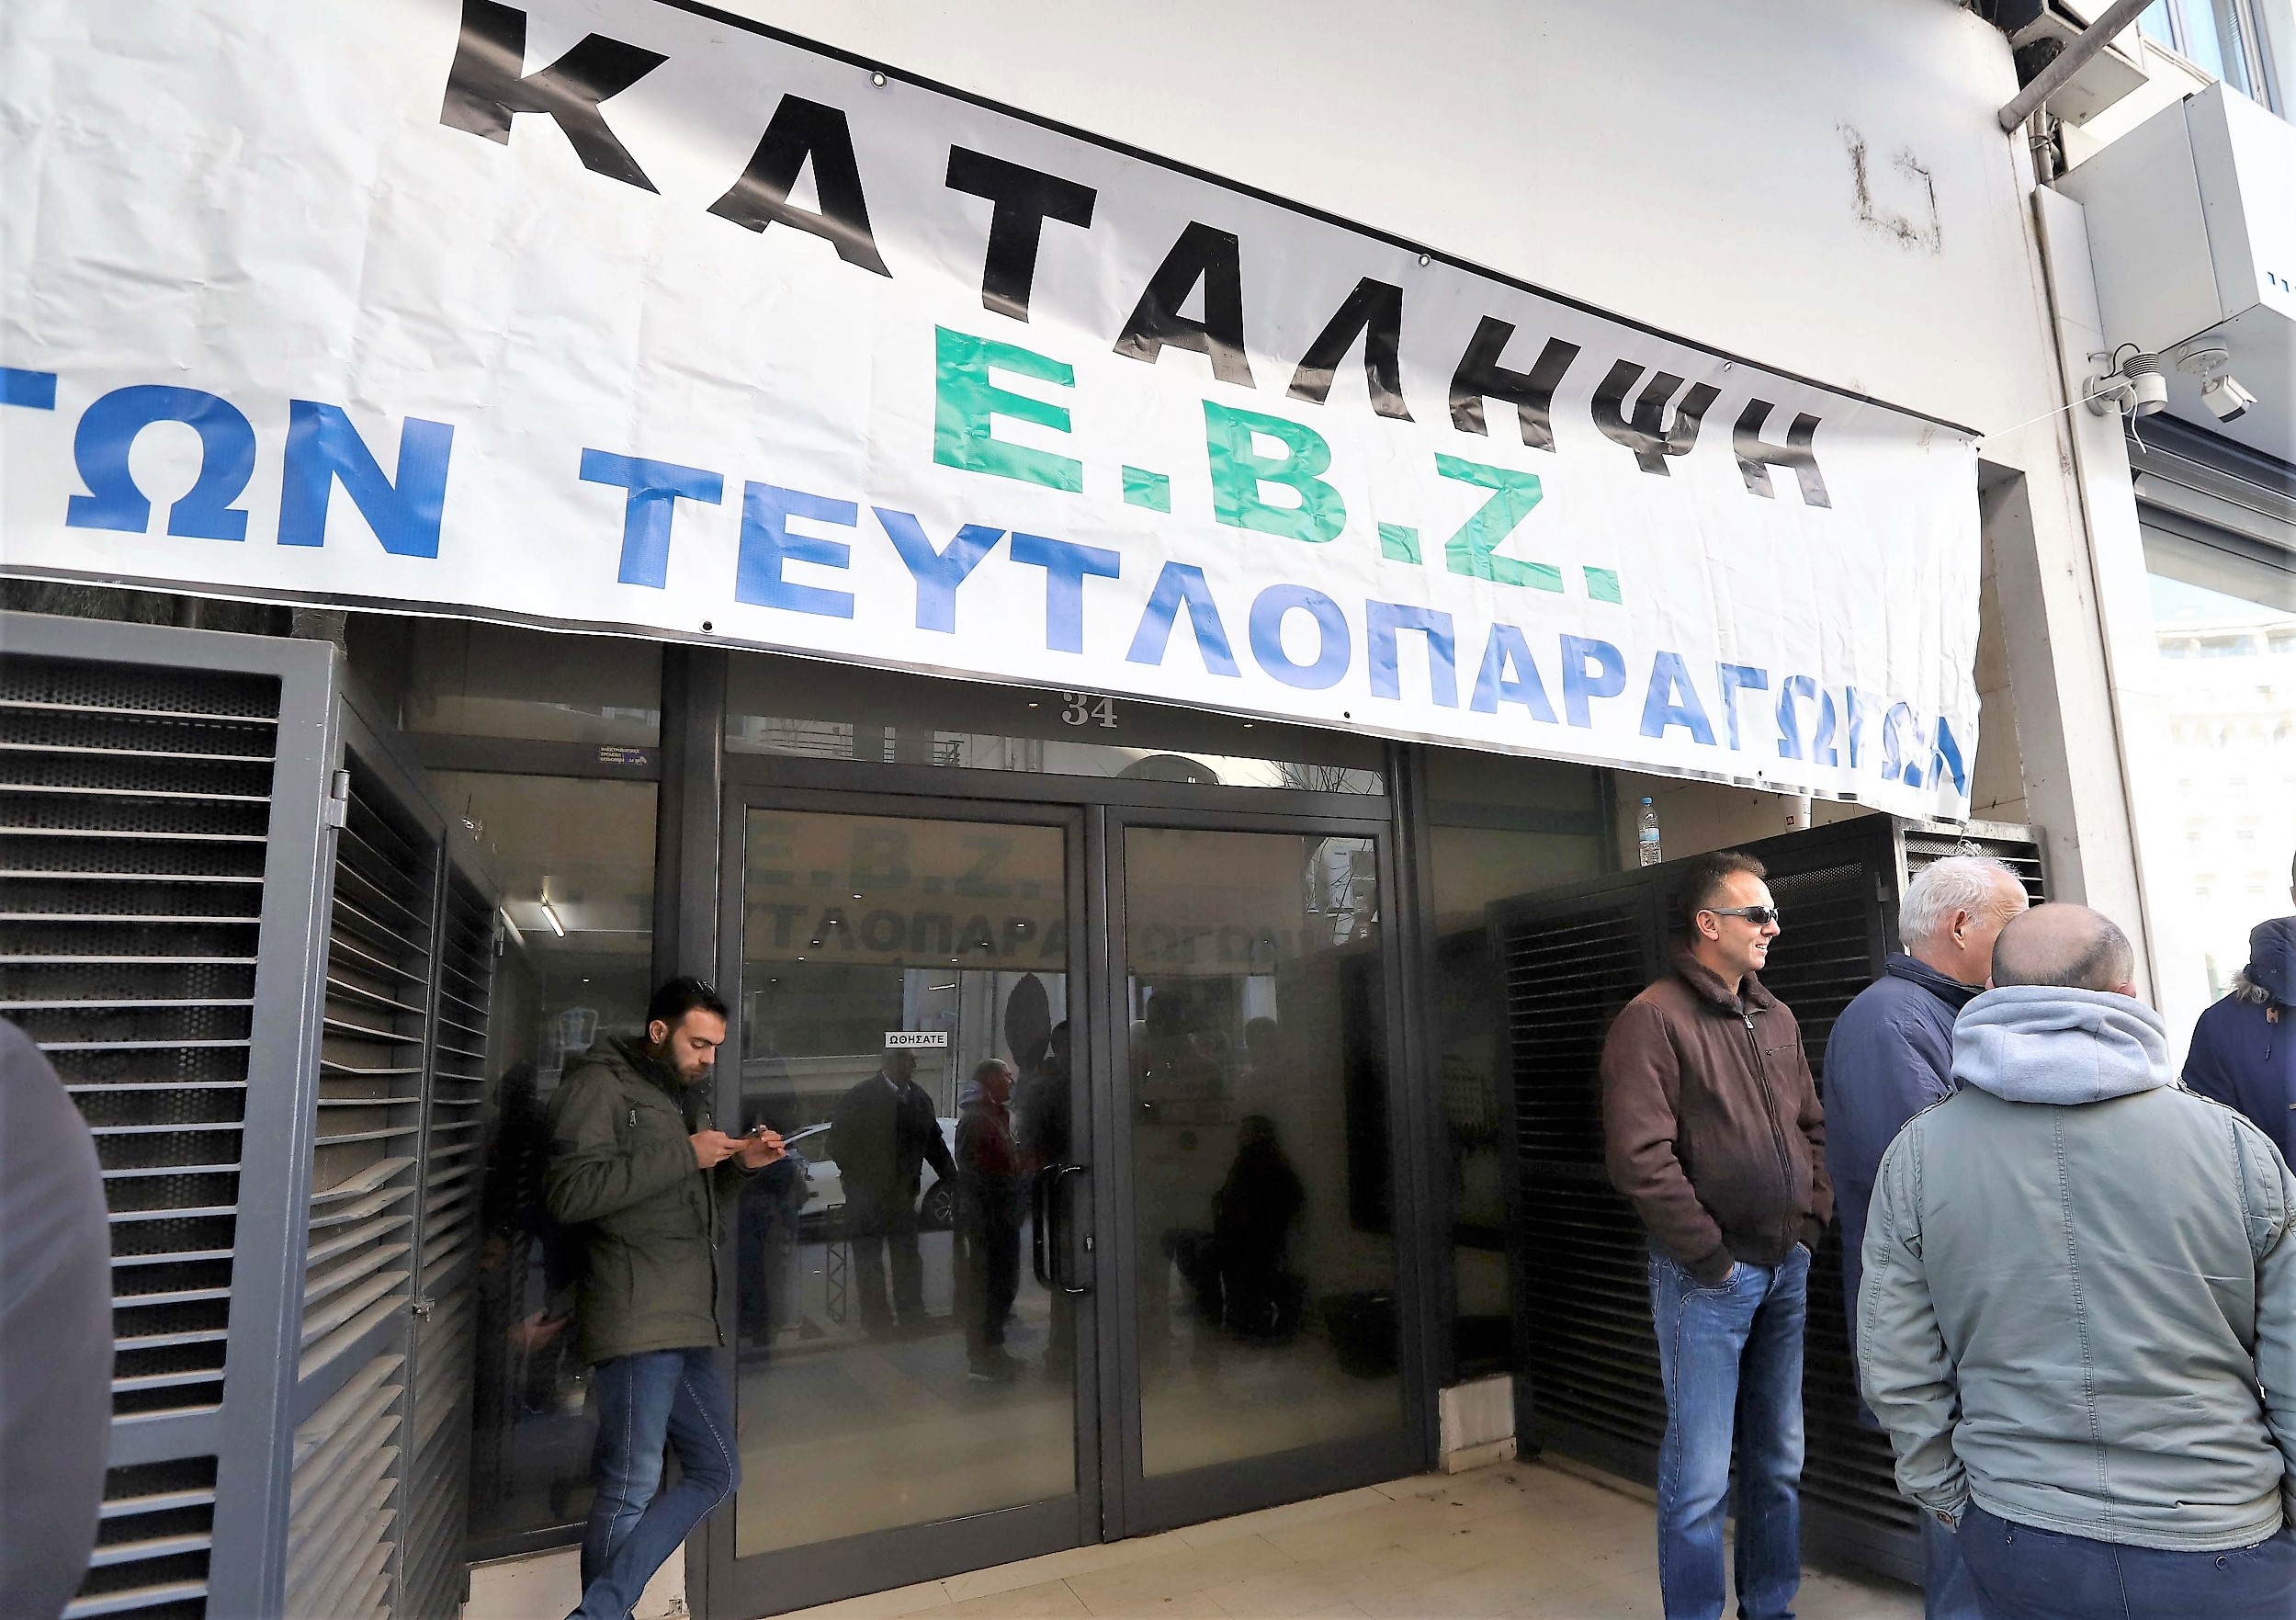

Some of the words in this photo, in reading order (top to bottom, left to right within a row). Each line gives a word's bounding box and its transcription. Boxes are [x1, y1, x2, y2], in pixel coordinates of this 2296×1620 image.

[440, 0, 1832, 509] ΚΑΤΑΛΗΨΗ
[0, 368, 454, 559] ΩΝ
[933, 323, 1622, 605] Ε.Β.Ζ.
[1062, 693, 1118, 728] 34
[889, 1035, 944, 1045] ΩΘΗΣΑΤΕ
